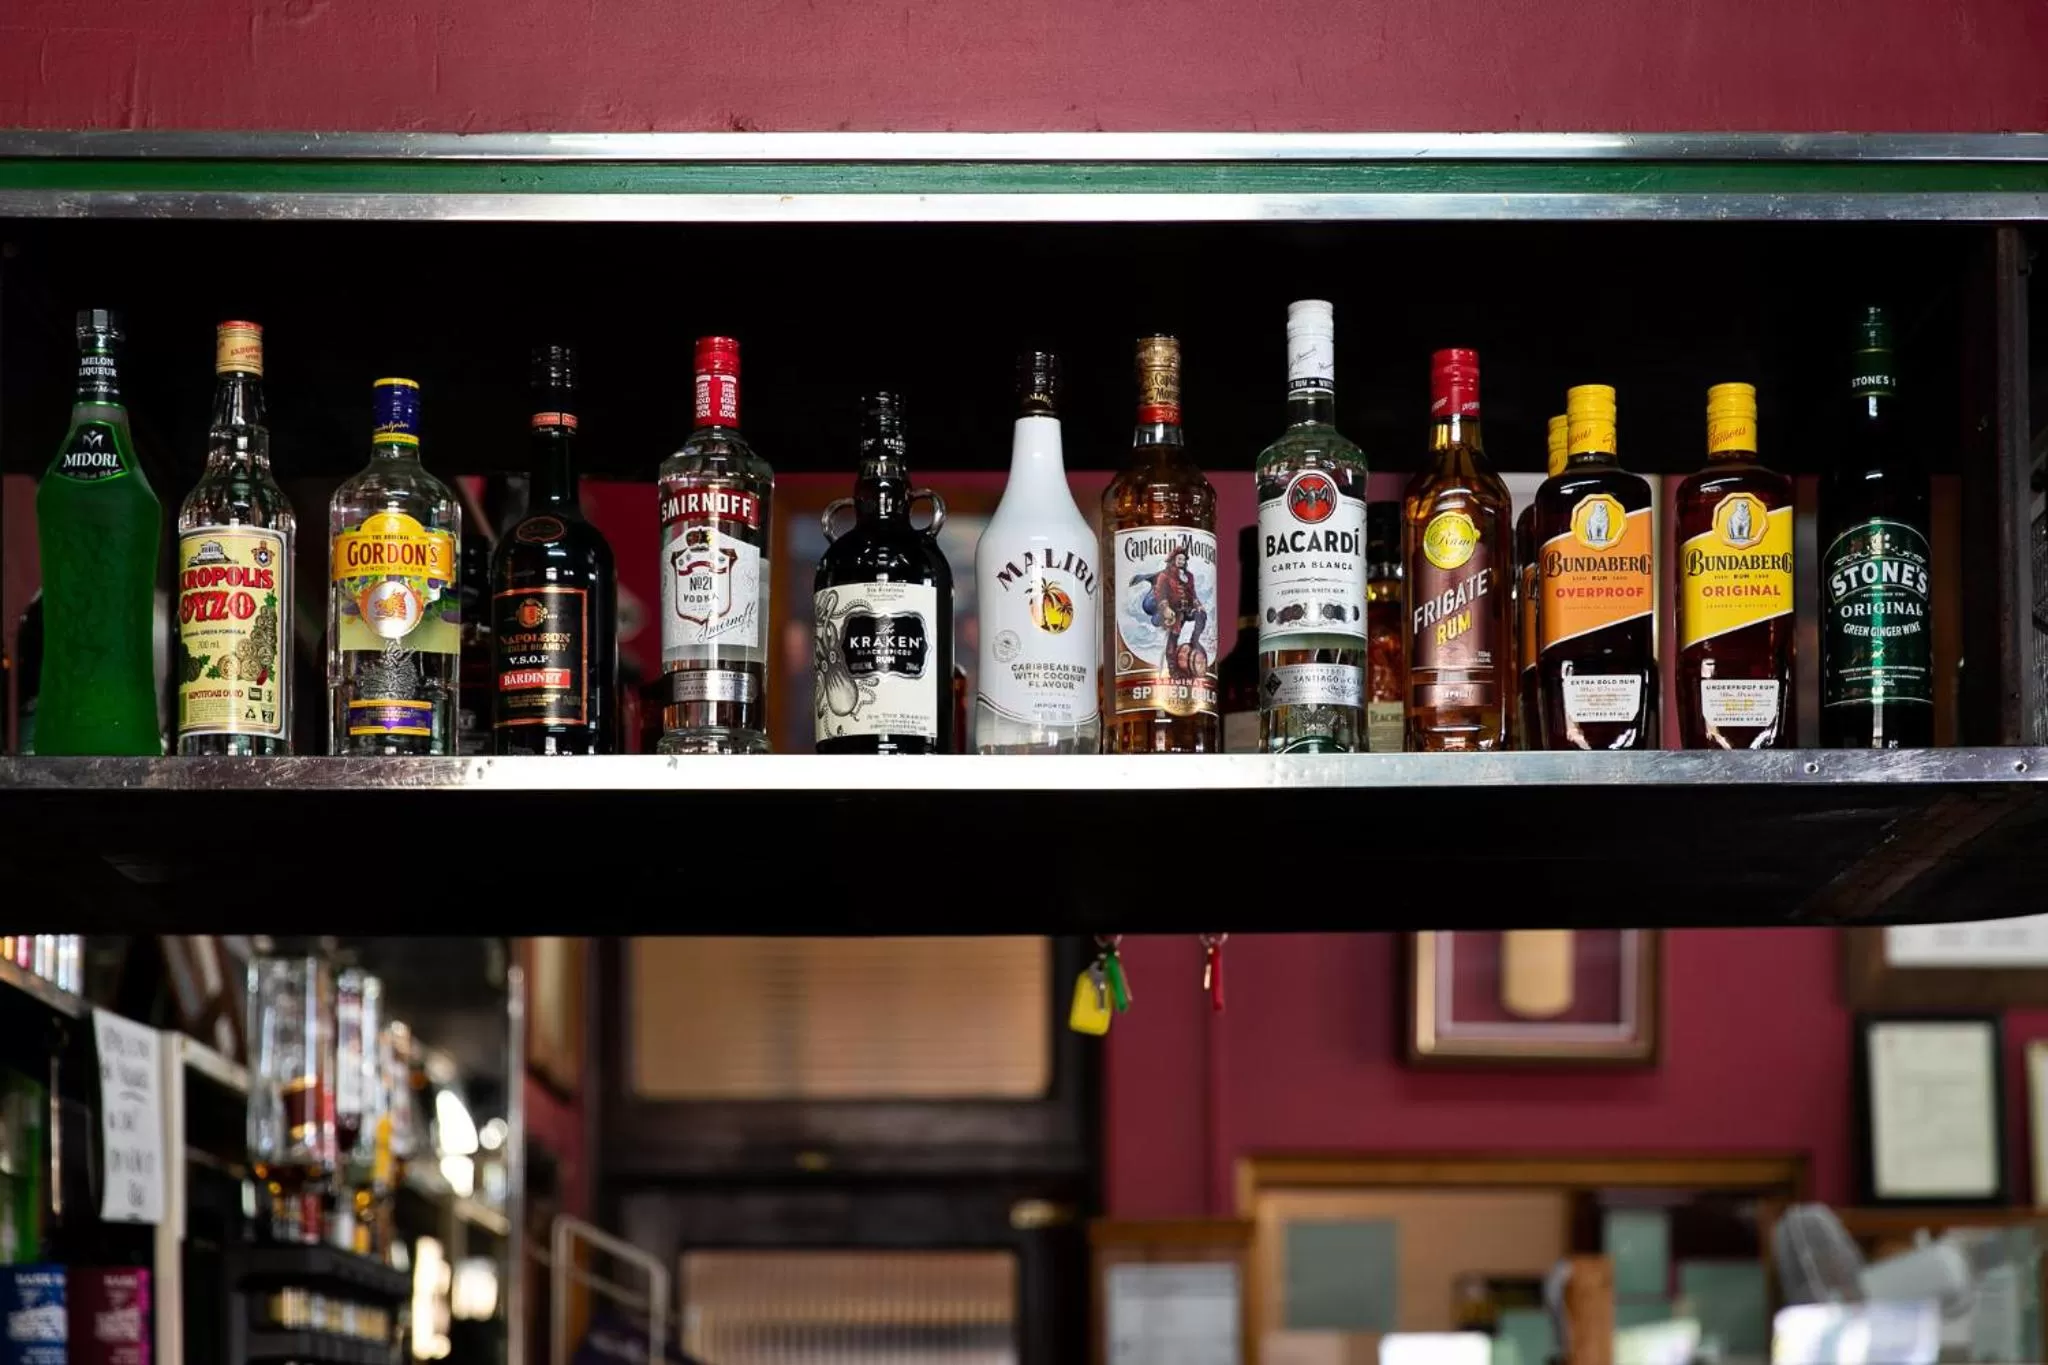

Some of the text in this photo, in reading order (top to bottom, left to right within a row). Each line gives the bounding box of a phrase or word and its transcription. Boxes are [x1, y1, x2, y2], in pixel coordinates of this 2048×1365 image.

[81, 356, 114, 366] MELON
[78, 366, 117, 377] LIQUEUR
[1851, 376, 1890, 388] STONE'S
[63, 452, 118, 468] MIDORI
[661, 492, 752, 523] SMIRNOFF
[347, 540, 438, 567] GORDON'S
[1124, 533, 1217, 565] Captain Morga
[1271, 561, 1353, 573] CARTA BLANCA
[1545, 550, 1653, 578] BUNDABERG
[1685, 548, 1794, 577] BUNDABERG
[182, 566, 274, 591] ROPOLIS
[996, 548, 1099, 600] MALIBU
[1831, 560, 1928, 598] STONE'S
[683, 593, 720, 603] VODKA
[1556, 586, 1645, 598] OVERPROOF
[1702, 584, 1781, 598] ORIGINAL
[1413, 568, 1489, 636] FRIGATE
[1840, 600, 1924, 619] ORIGINAL
[1435, 608, 1473, 646] RUM
[1843, 621, 1922, 638] GREEN GINGER WINE
[500, 631, 571, 646] NAPOLEON
[850, 635, 921, 649] KRAKEN
[876, 655, 896, 665] RUM
[1011, 662, 1087, 675] CARIBBEAN RUM
[504, 672, 562, 687] BARDINET
[1013, 671, 1086, 684] WITH COCONUT
[1293, 674, 1339, 684] SANTIAGO
[1028, 681, 1075, 690] FLAVOUR
